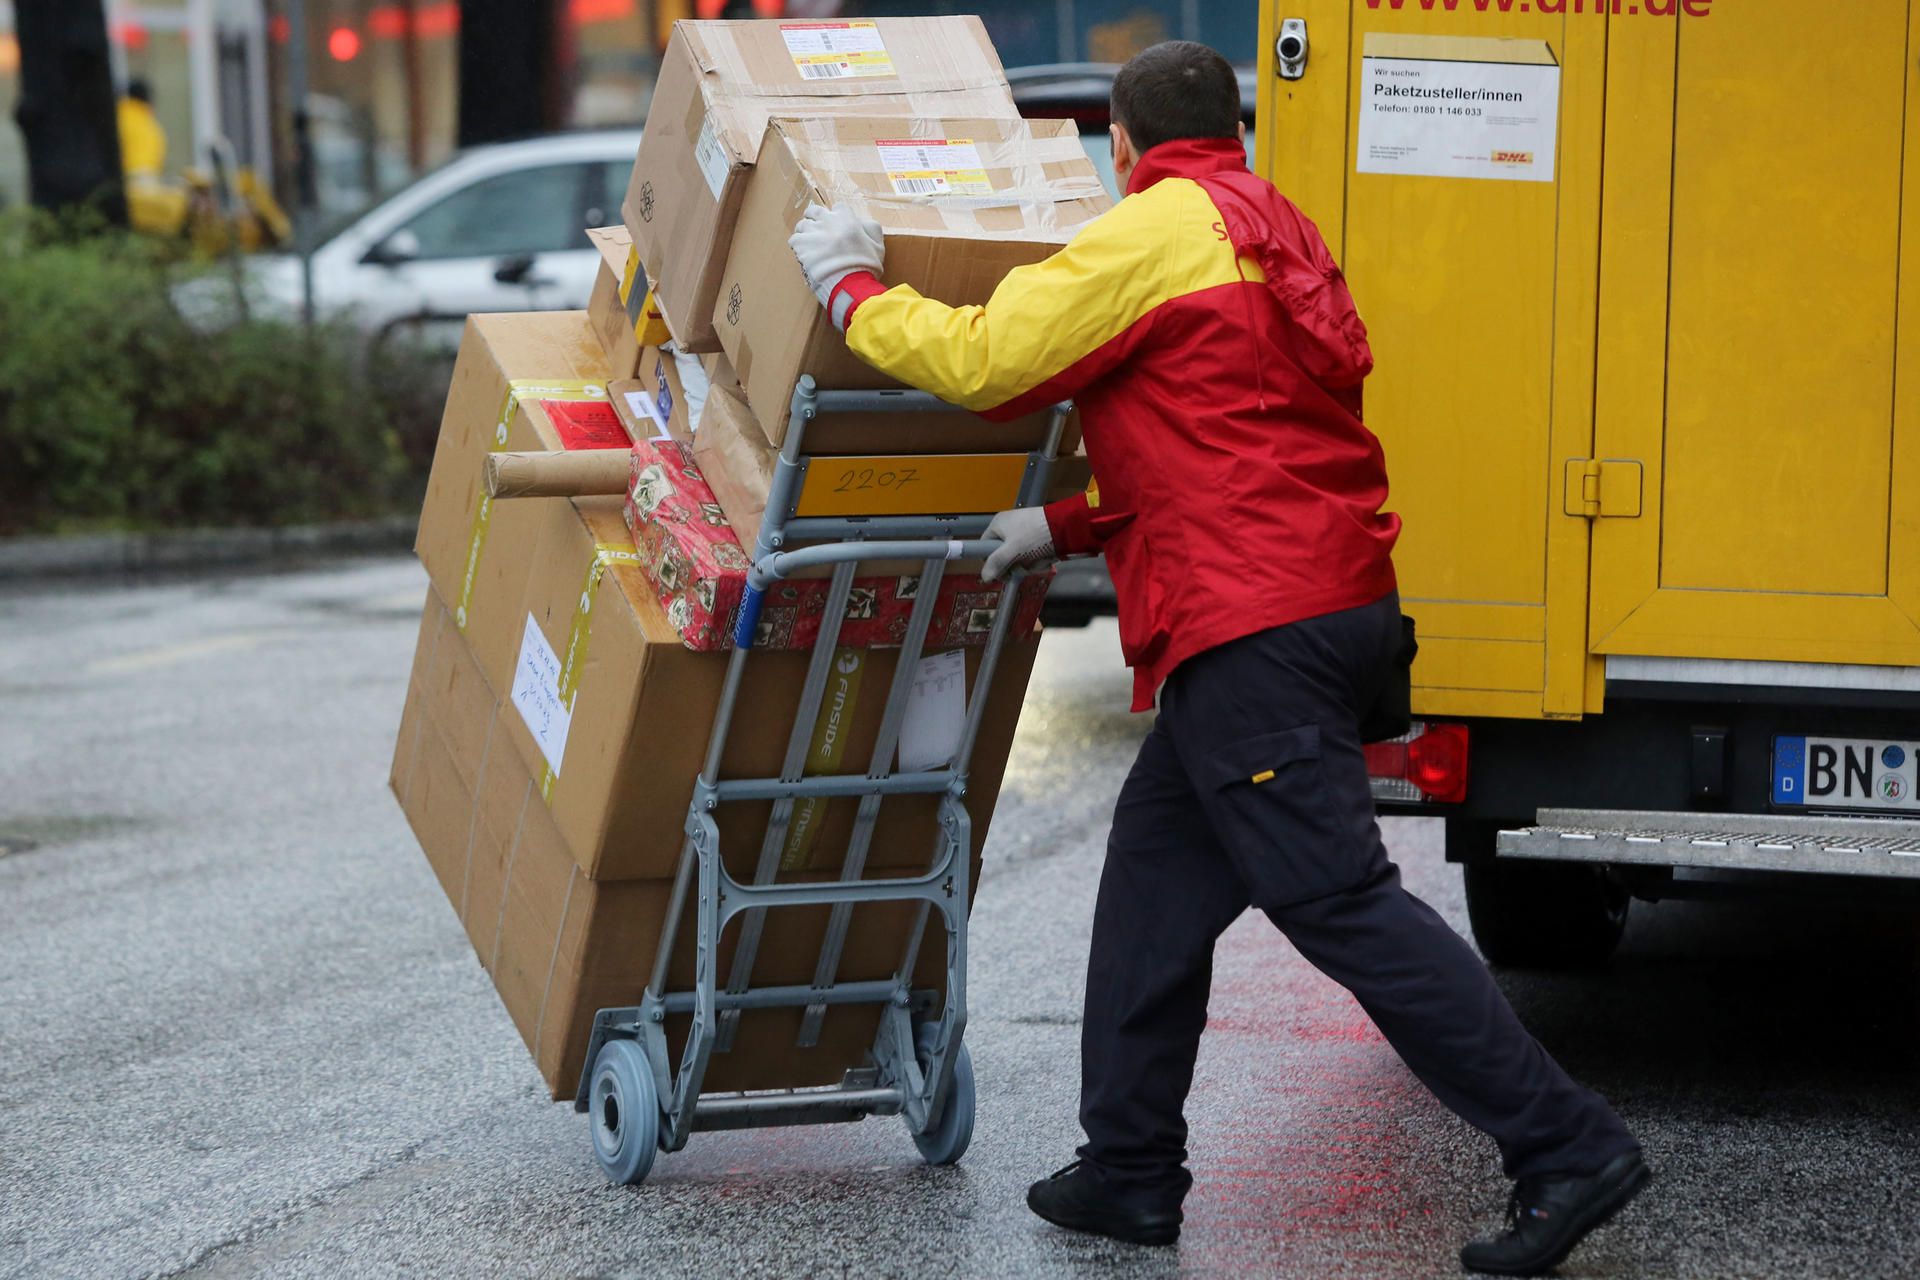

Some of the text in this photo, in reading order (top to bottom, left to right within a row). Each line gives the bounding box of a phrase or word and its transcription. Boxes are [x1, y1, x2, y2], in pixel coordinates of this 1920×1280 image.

[1374, 68, 1420, 78] Wir suchen
[1374, 83, 1523, 102] Paketzusteller/innen
[1374, 103, 1411, 113] Telefon:
[1413, 105, 1435, 115] 0180
[1447, 107, 1463, 116] 146
[1465, 107, 1482, 117] 033
[1496, 152, 1528, 163] DHL
[834, 468, 920, 492] 2207
[821, 678, 848, 757] FINSIDE
[1782, 776, 1794, 792] D
